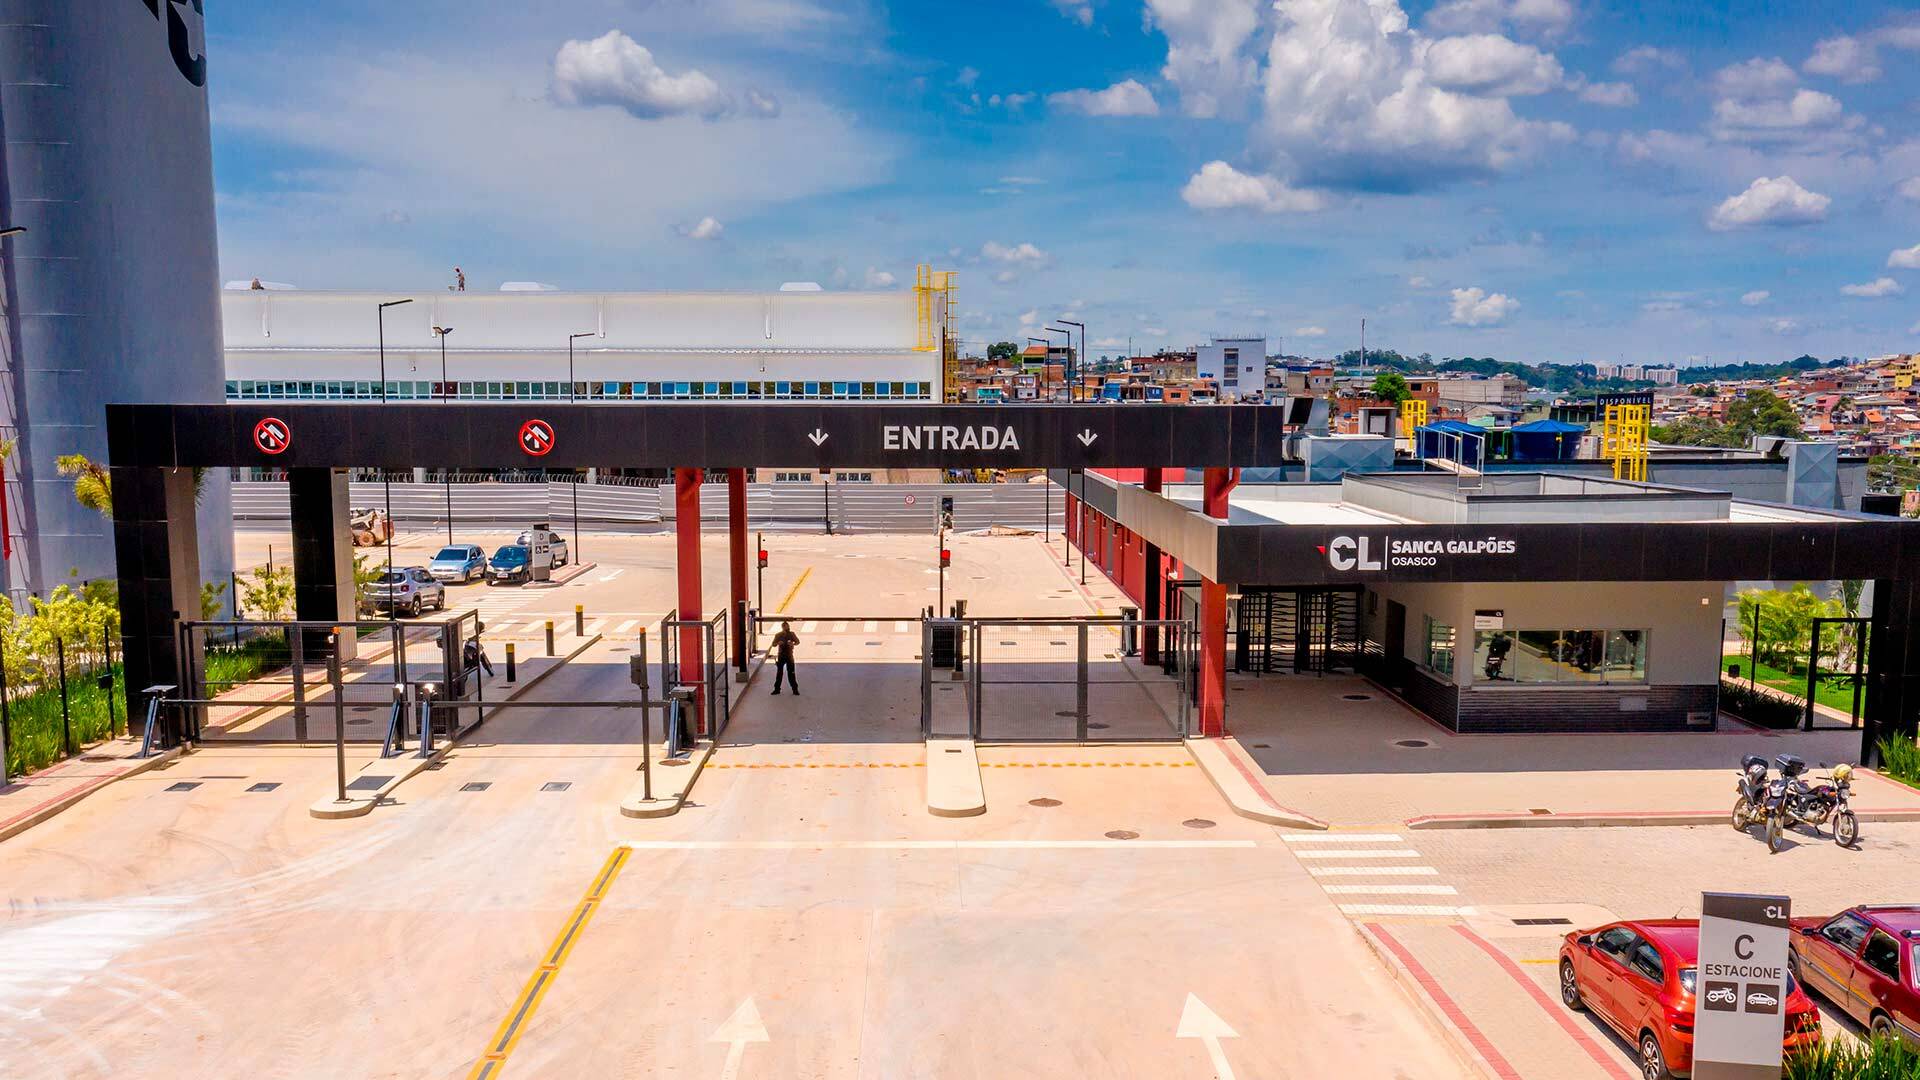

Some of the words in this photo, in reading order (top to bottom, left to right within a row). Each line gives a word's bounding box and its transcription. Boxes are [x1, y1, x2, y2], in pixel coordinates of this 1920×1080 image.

[1600, 395, 1651, 406] DISPONÍVEL
[883, 425, 1020, 450] ENTRADA
[1329, 536, 1382, 571] CL
[1392, 540, 1444, 554] SANCA
[1447, 537, 1516, 554] GALPÕES
[1392, 557, 1437, 566] OSASCO
[1766, 905, 1787, 919] CL
[1734, 934, 1755, 960] C
[1705, 964, 1781, 979] ESTACIONE
